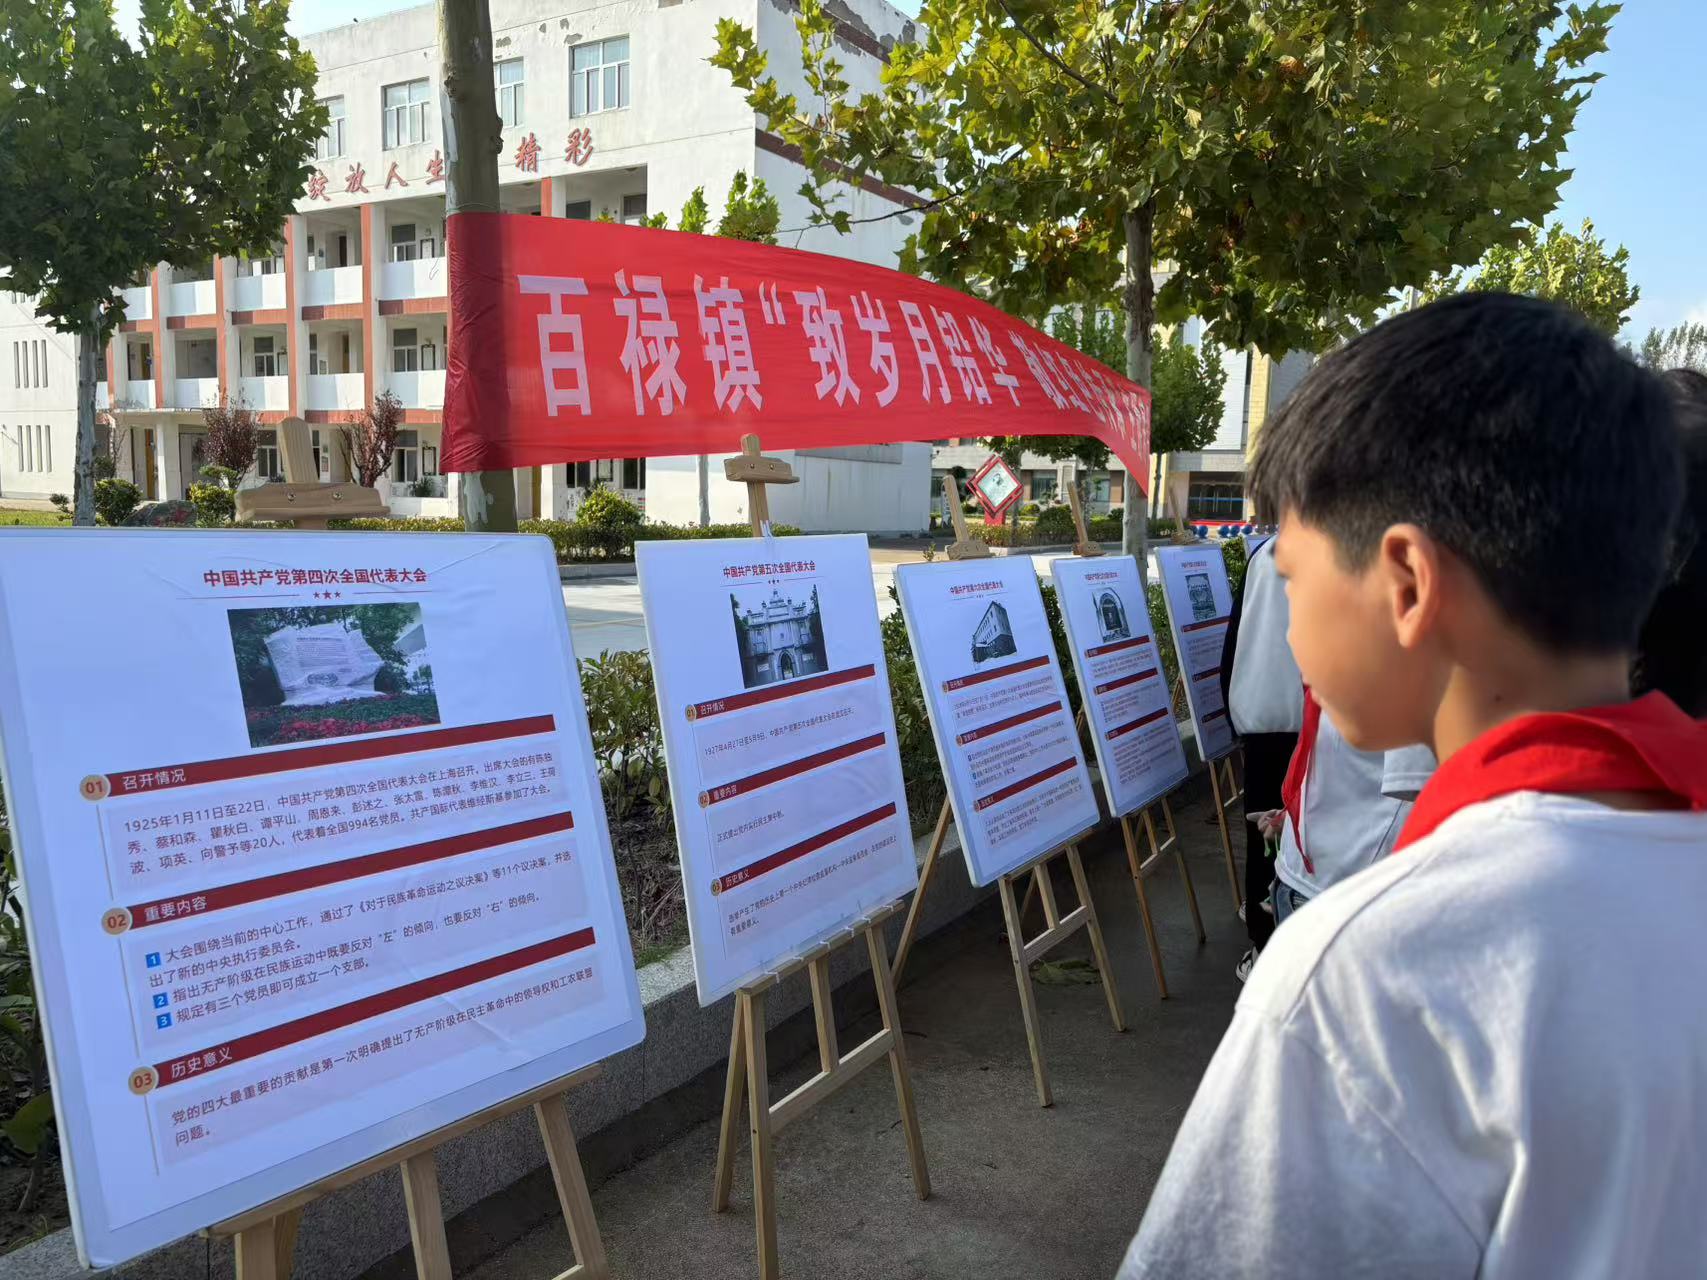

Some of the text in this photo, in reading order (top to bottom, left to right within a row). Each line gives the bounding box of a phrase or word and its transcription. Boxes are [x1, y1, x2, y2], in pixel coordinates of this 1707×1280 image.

[203, 567, 427, 588] 中国共产党第四次全国代表大会
[723, 560, 816, 579] 中国共产党第五次全国代表大会
[700, 701, 726, 715] 召开情况
[85, 768, 186, 795] 01 召开情况
[713, 784, 738, 801] 重要内容
[725, 868, 750, 887] 历史意义
[106, 895, 208, 929] 02 重要内容
[149, 939, 301, 988] 出了新的中央执行委员会。
[176, 956, 369, 1023] 规定有三个党员即可成立一个支部。
[171, 967, 593, 1126] 党的四大最重要的贡献是第一次明确提出了无产阶级在民主革命中的领导权和工农联盟
[132, 1047, 233, 1089] 03 历史意义
[175, 1125, 211, 1147] 问题。
